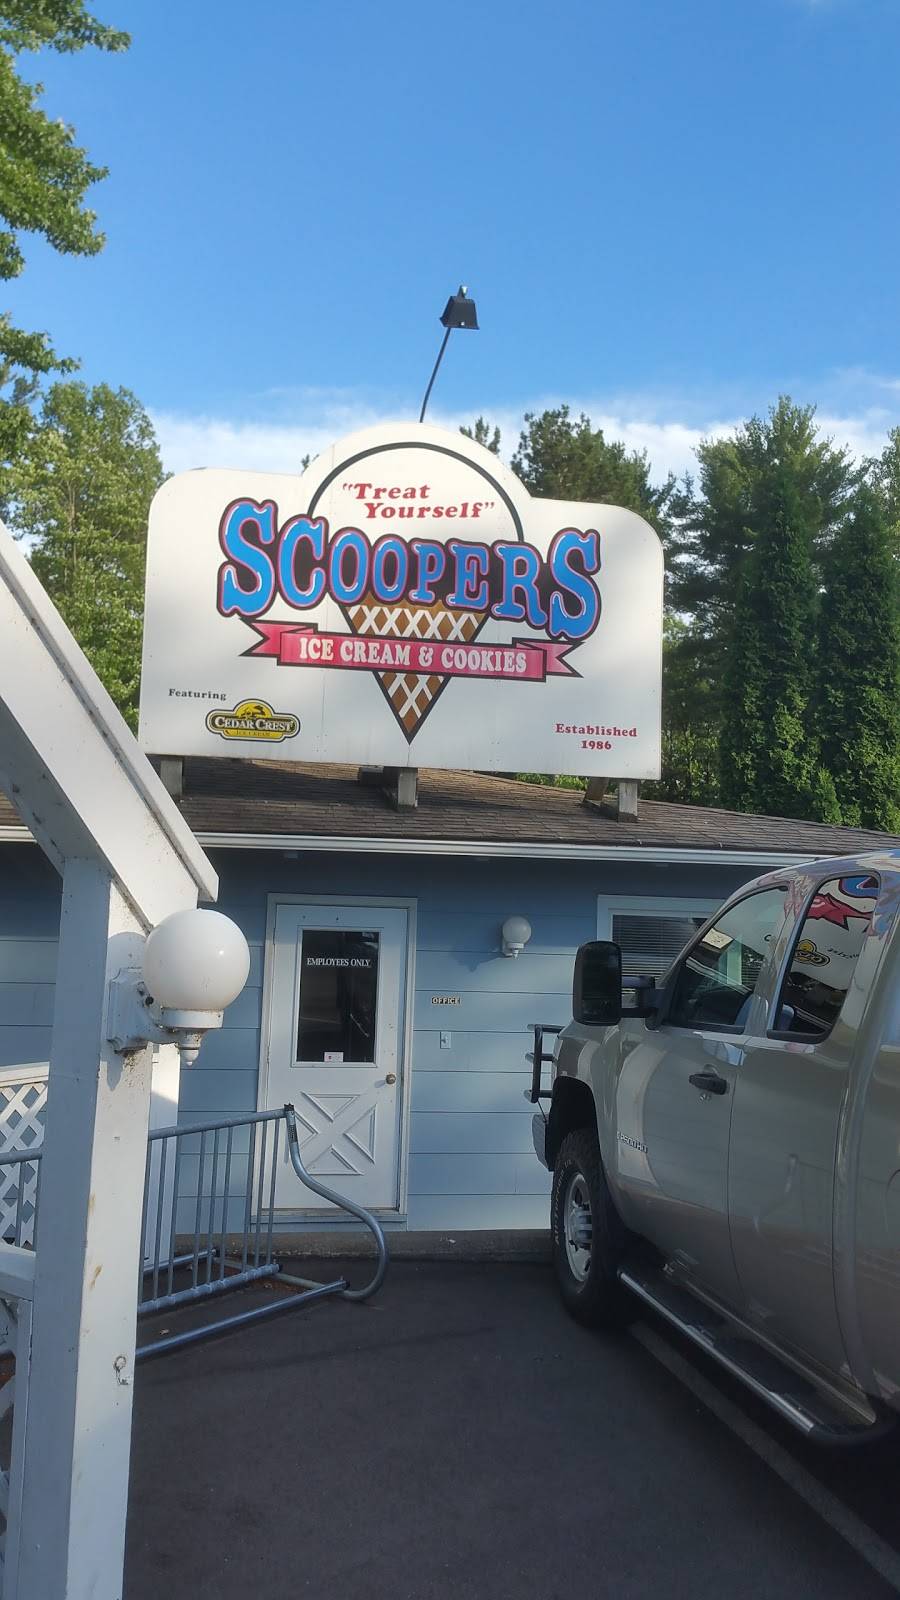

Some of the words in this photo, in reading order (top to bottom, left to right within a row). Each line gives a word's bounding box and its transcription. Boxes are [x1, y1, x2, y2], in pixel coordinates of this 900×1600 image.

[217, 497, 601, 639] SCOOPERS
[300, 637, 334, 660] ICE
[340, 640, 411, 666] CREAM
[418, 646, 434, 667] &
[441, 648, 527, 673] COOKIES
[168, 688, 227, 701] Featuring
[215, 716, 255, 730] CEDAR
[255, 718, 294, 732] CREST
[555, 723, 637, 737] Established
[581, 740, 612, 750] 1986
[307, 957, 349, 967] EMPLOYEES
[350, 958, 370, 968] ONLY
